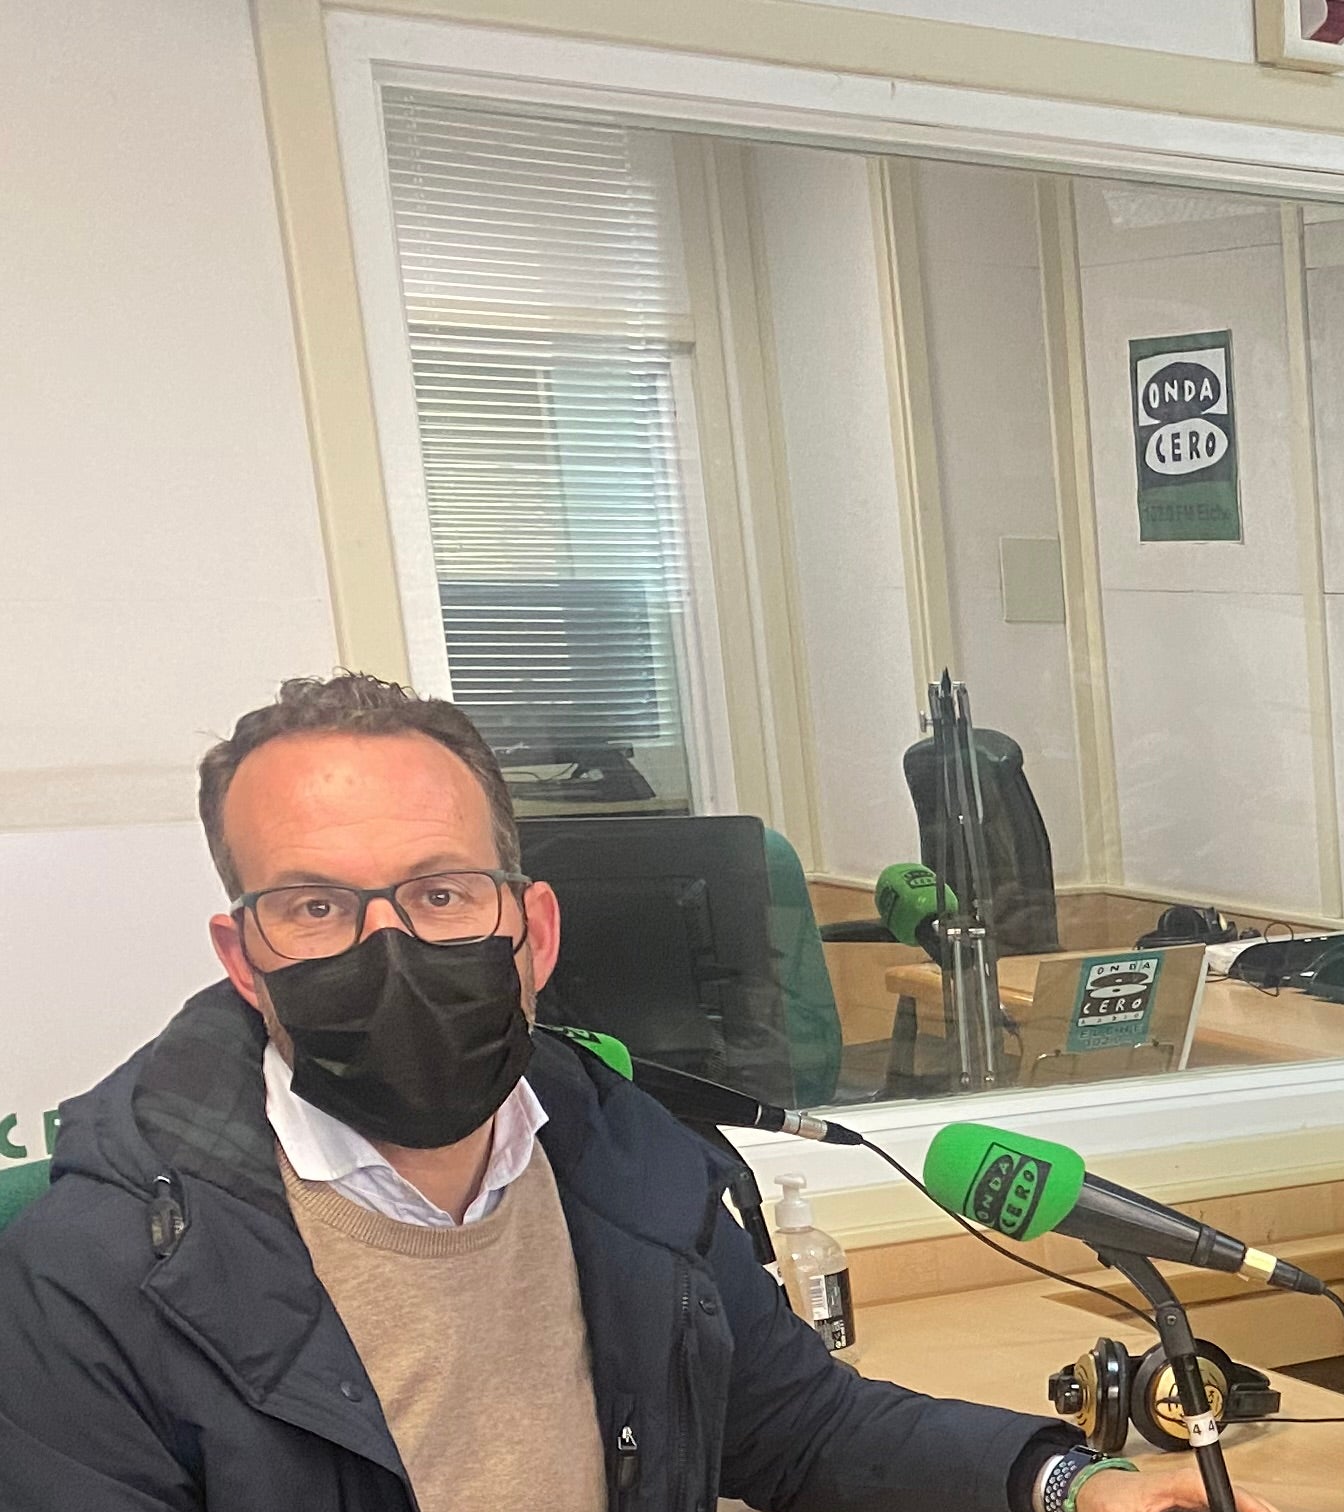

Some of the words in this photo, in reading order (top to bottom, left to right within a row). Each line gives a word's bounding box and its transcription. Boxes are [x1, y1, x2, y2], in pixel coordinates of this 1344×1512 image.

[1149, 377, 1214, 408] ONDA
[1155, 431, 1217, 464] CERO
[1096, 961, 1151, 975] ONDA
[1083, 998, 1142, 1015] CERO
[976, 1162, 1010, 1221] ONDA
[1001, 1169, 1035, 1228] CERO
[1193, 1423, 1202, 1436] 4
